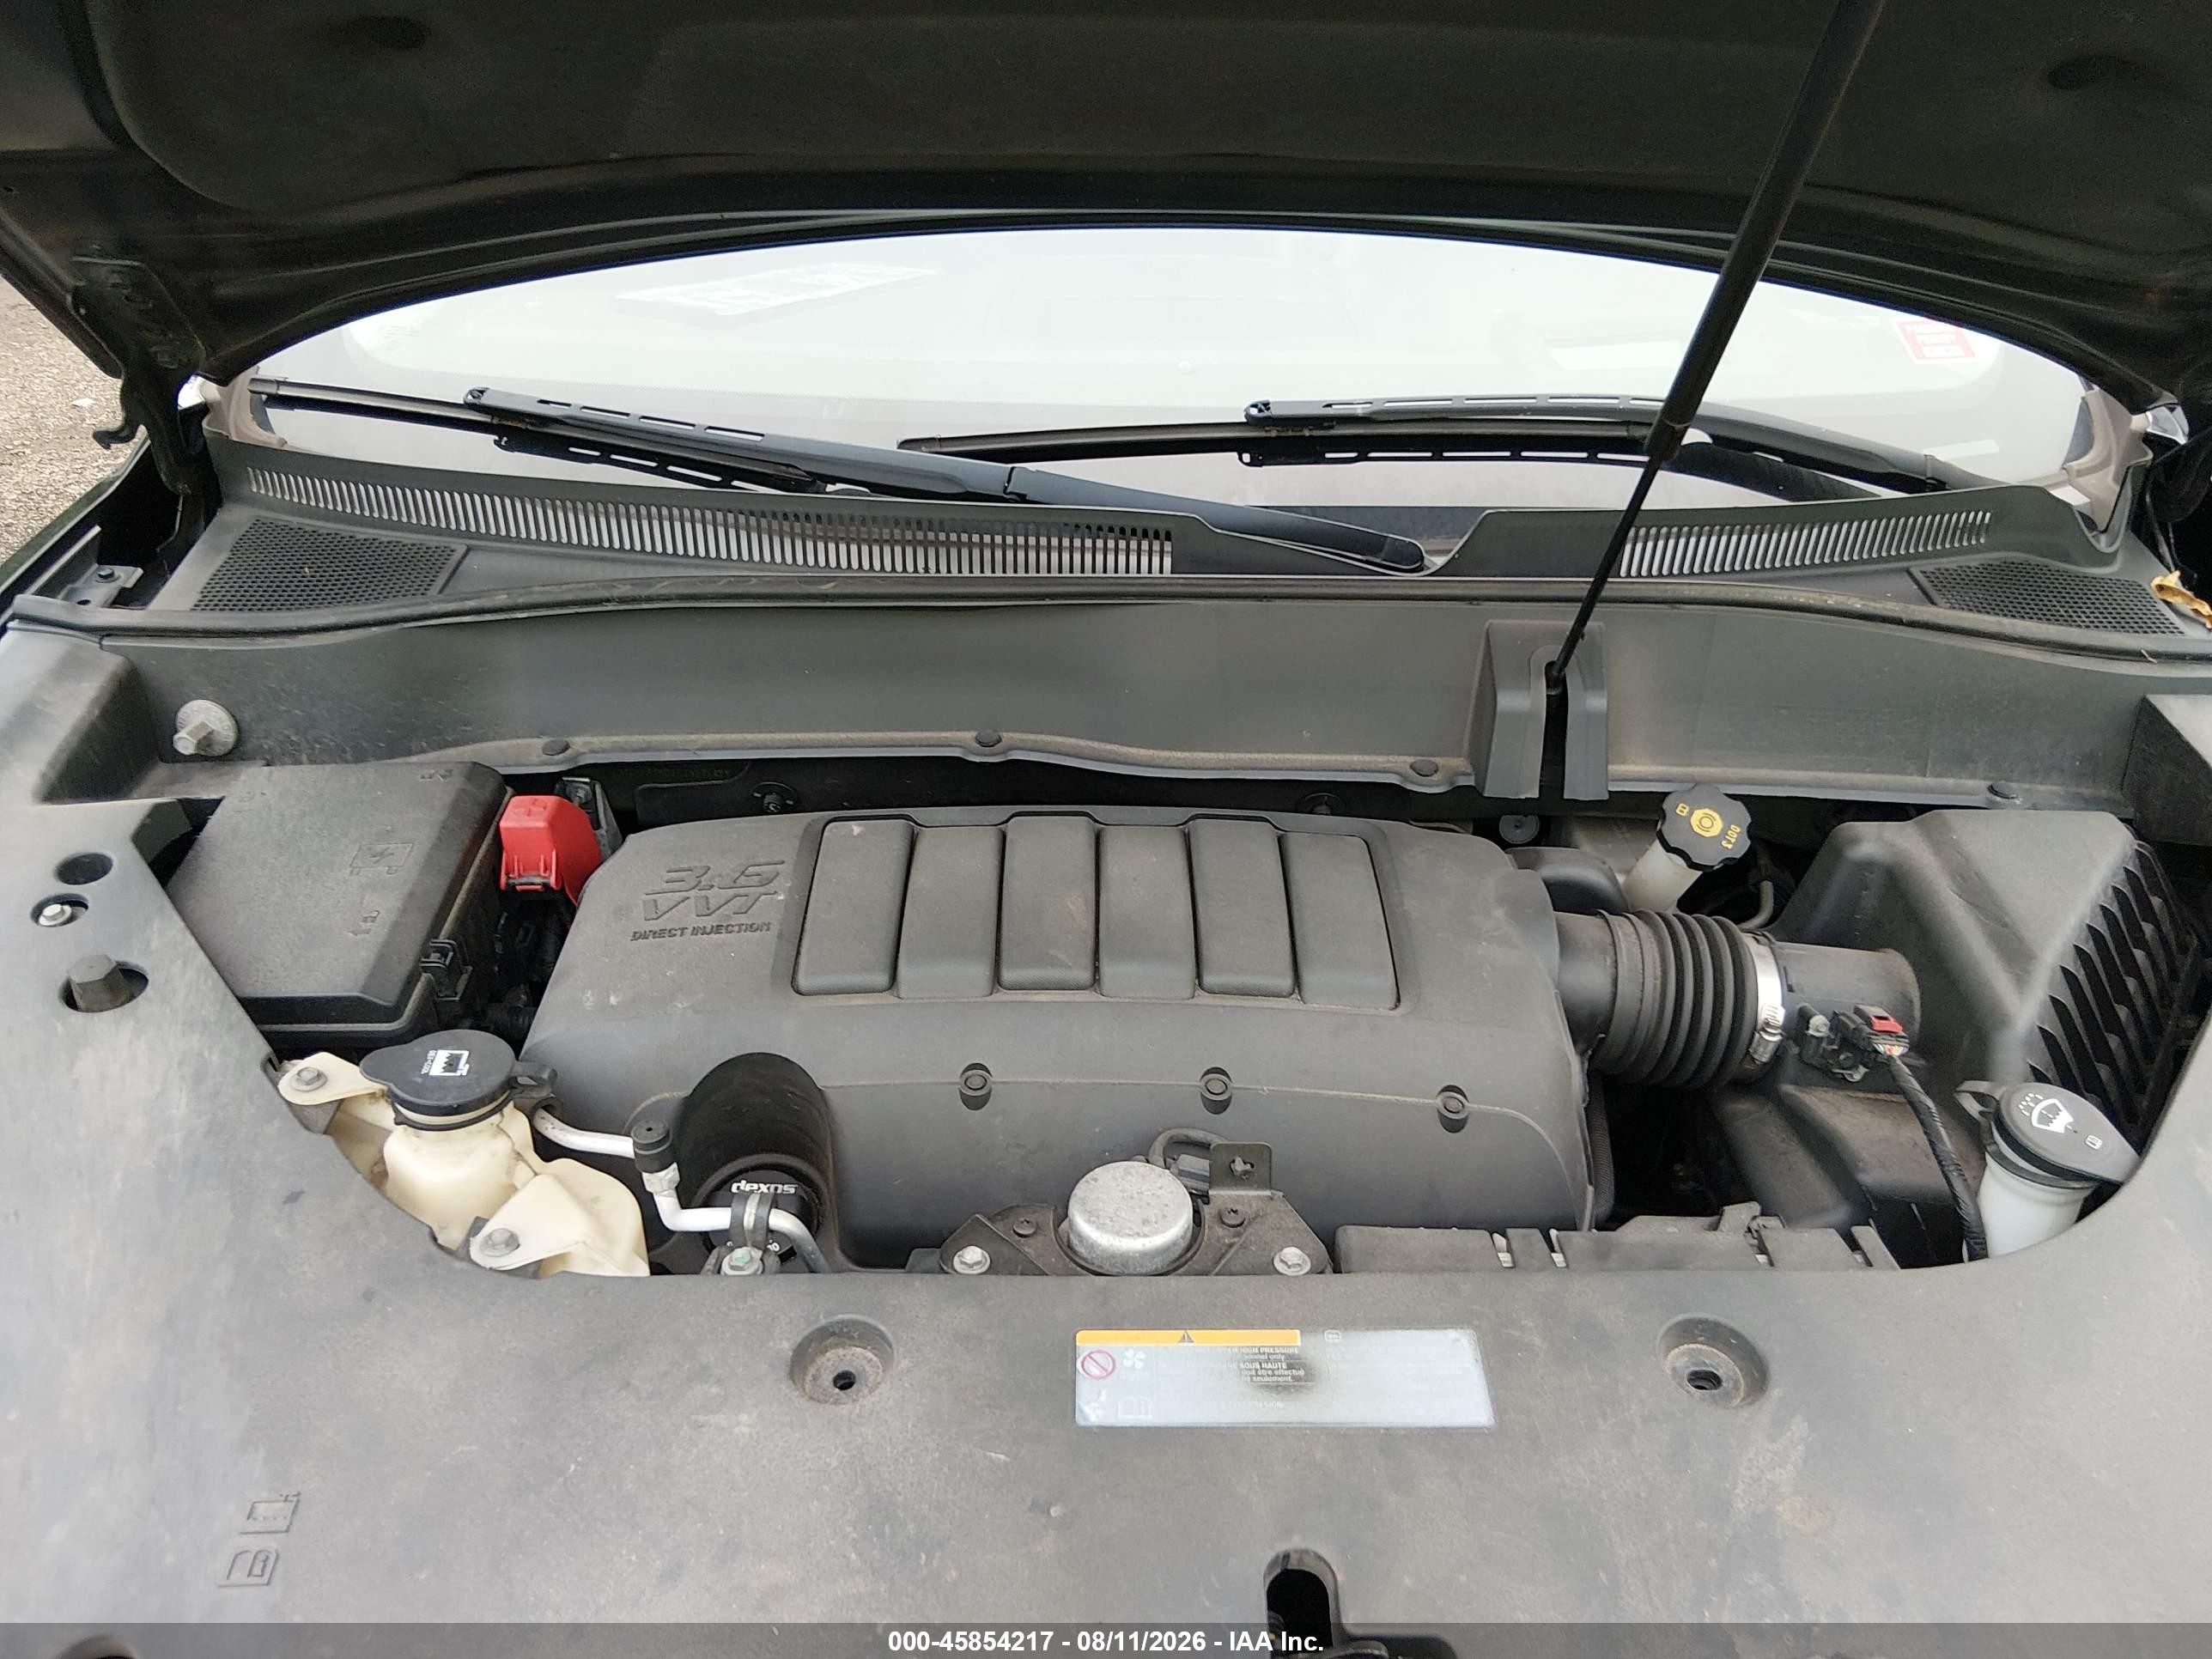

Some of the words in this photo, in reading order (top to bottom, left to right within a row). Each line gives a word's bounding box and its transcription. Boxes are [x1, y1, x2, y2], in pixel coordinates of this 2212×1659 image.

[645, 860, 785, 896] 3.6
[642, 890, 777, 921] VVT
[630, 926, 689, 942] DIRECT
[690, 921, 771, 937] INJECTION
